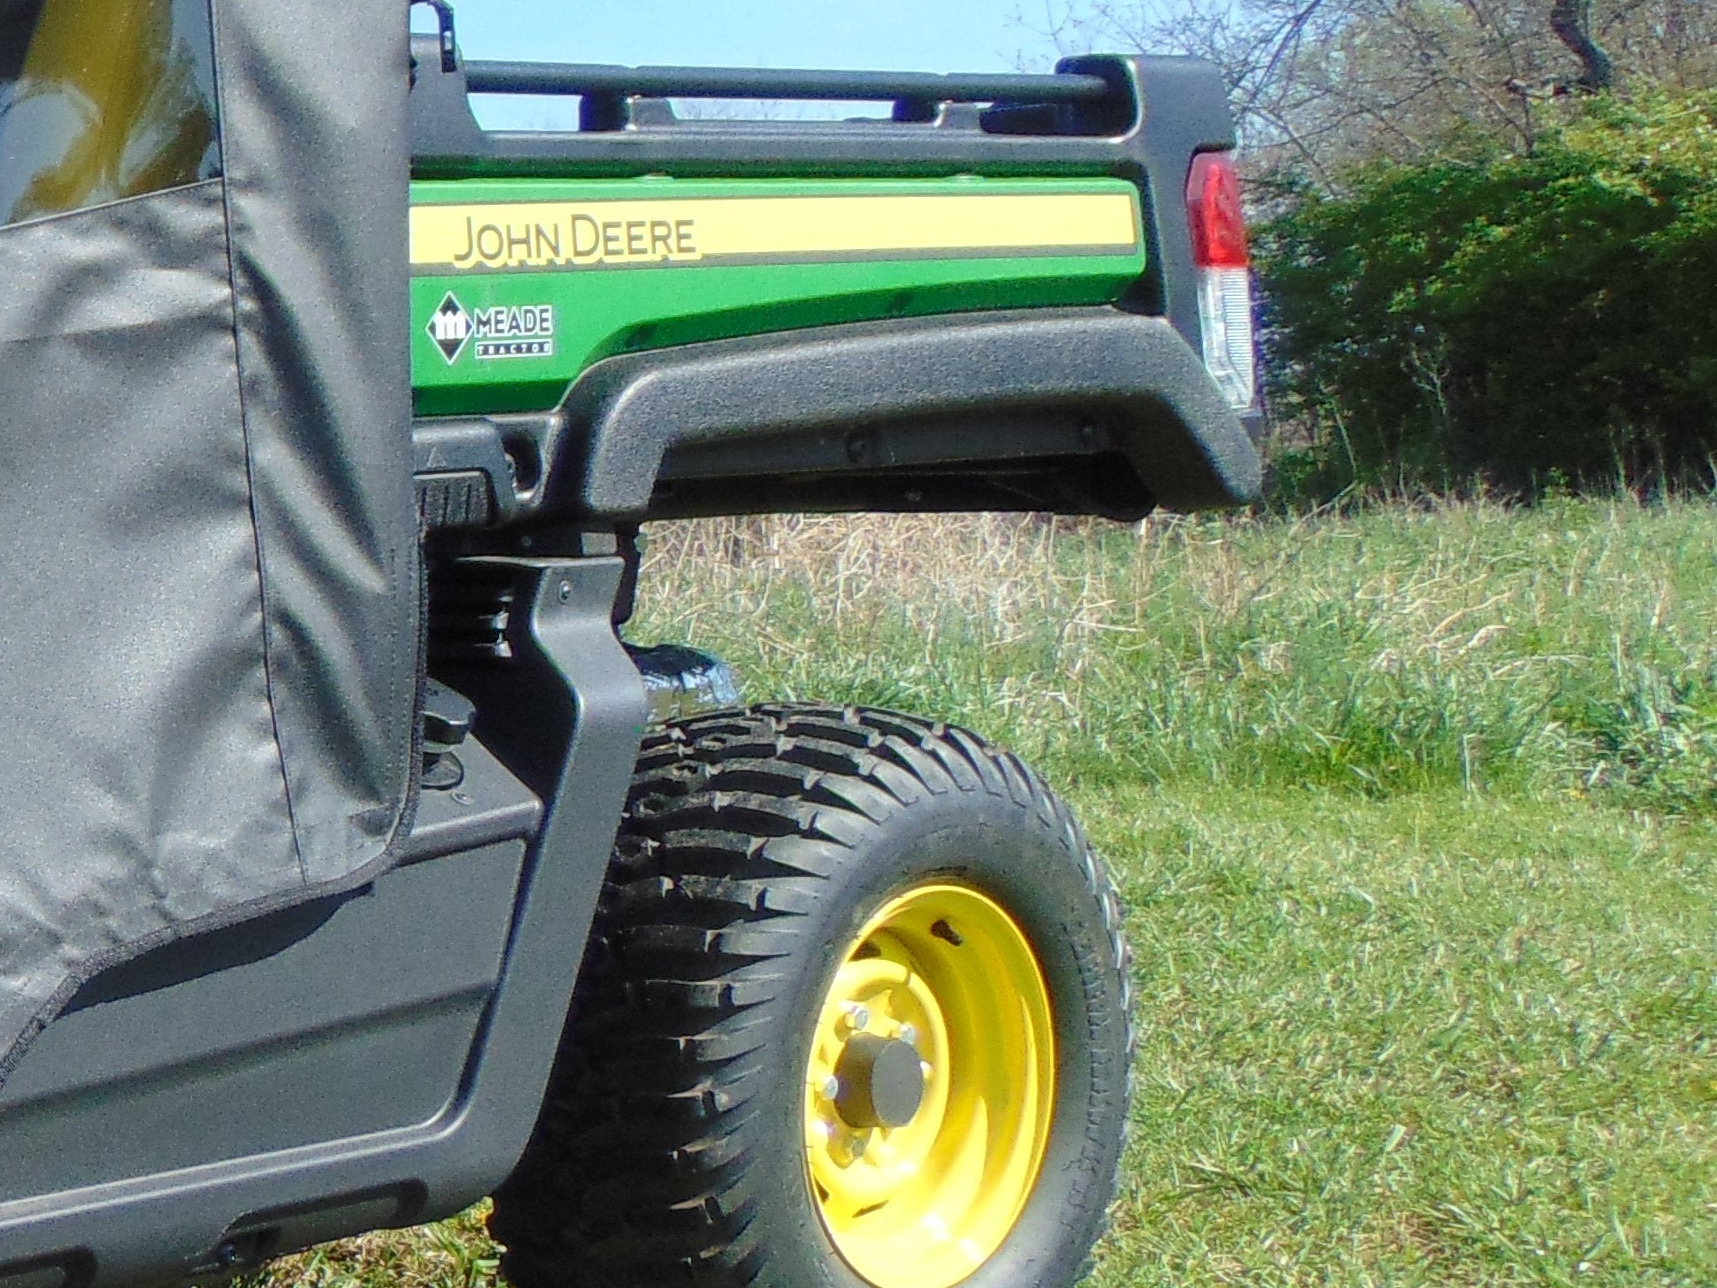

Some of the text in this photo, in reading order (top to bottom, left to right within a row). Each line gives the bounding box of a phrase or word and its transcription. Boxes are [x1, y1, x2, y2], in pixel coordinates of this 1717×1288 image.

[453, 213, 697, 261] JOHN DEERE
[474, 306, 551, 334] MEADE
